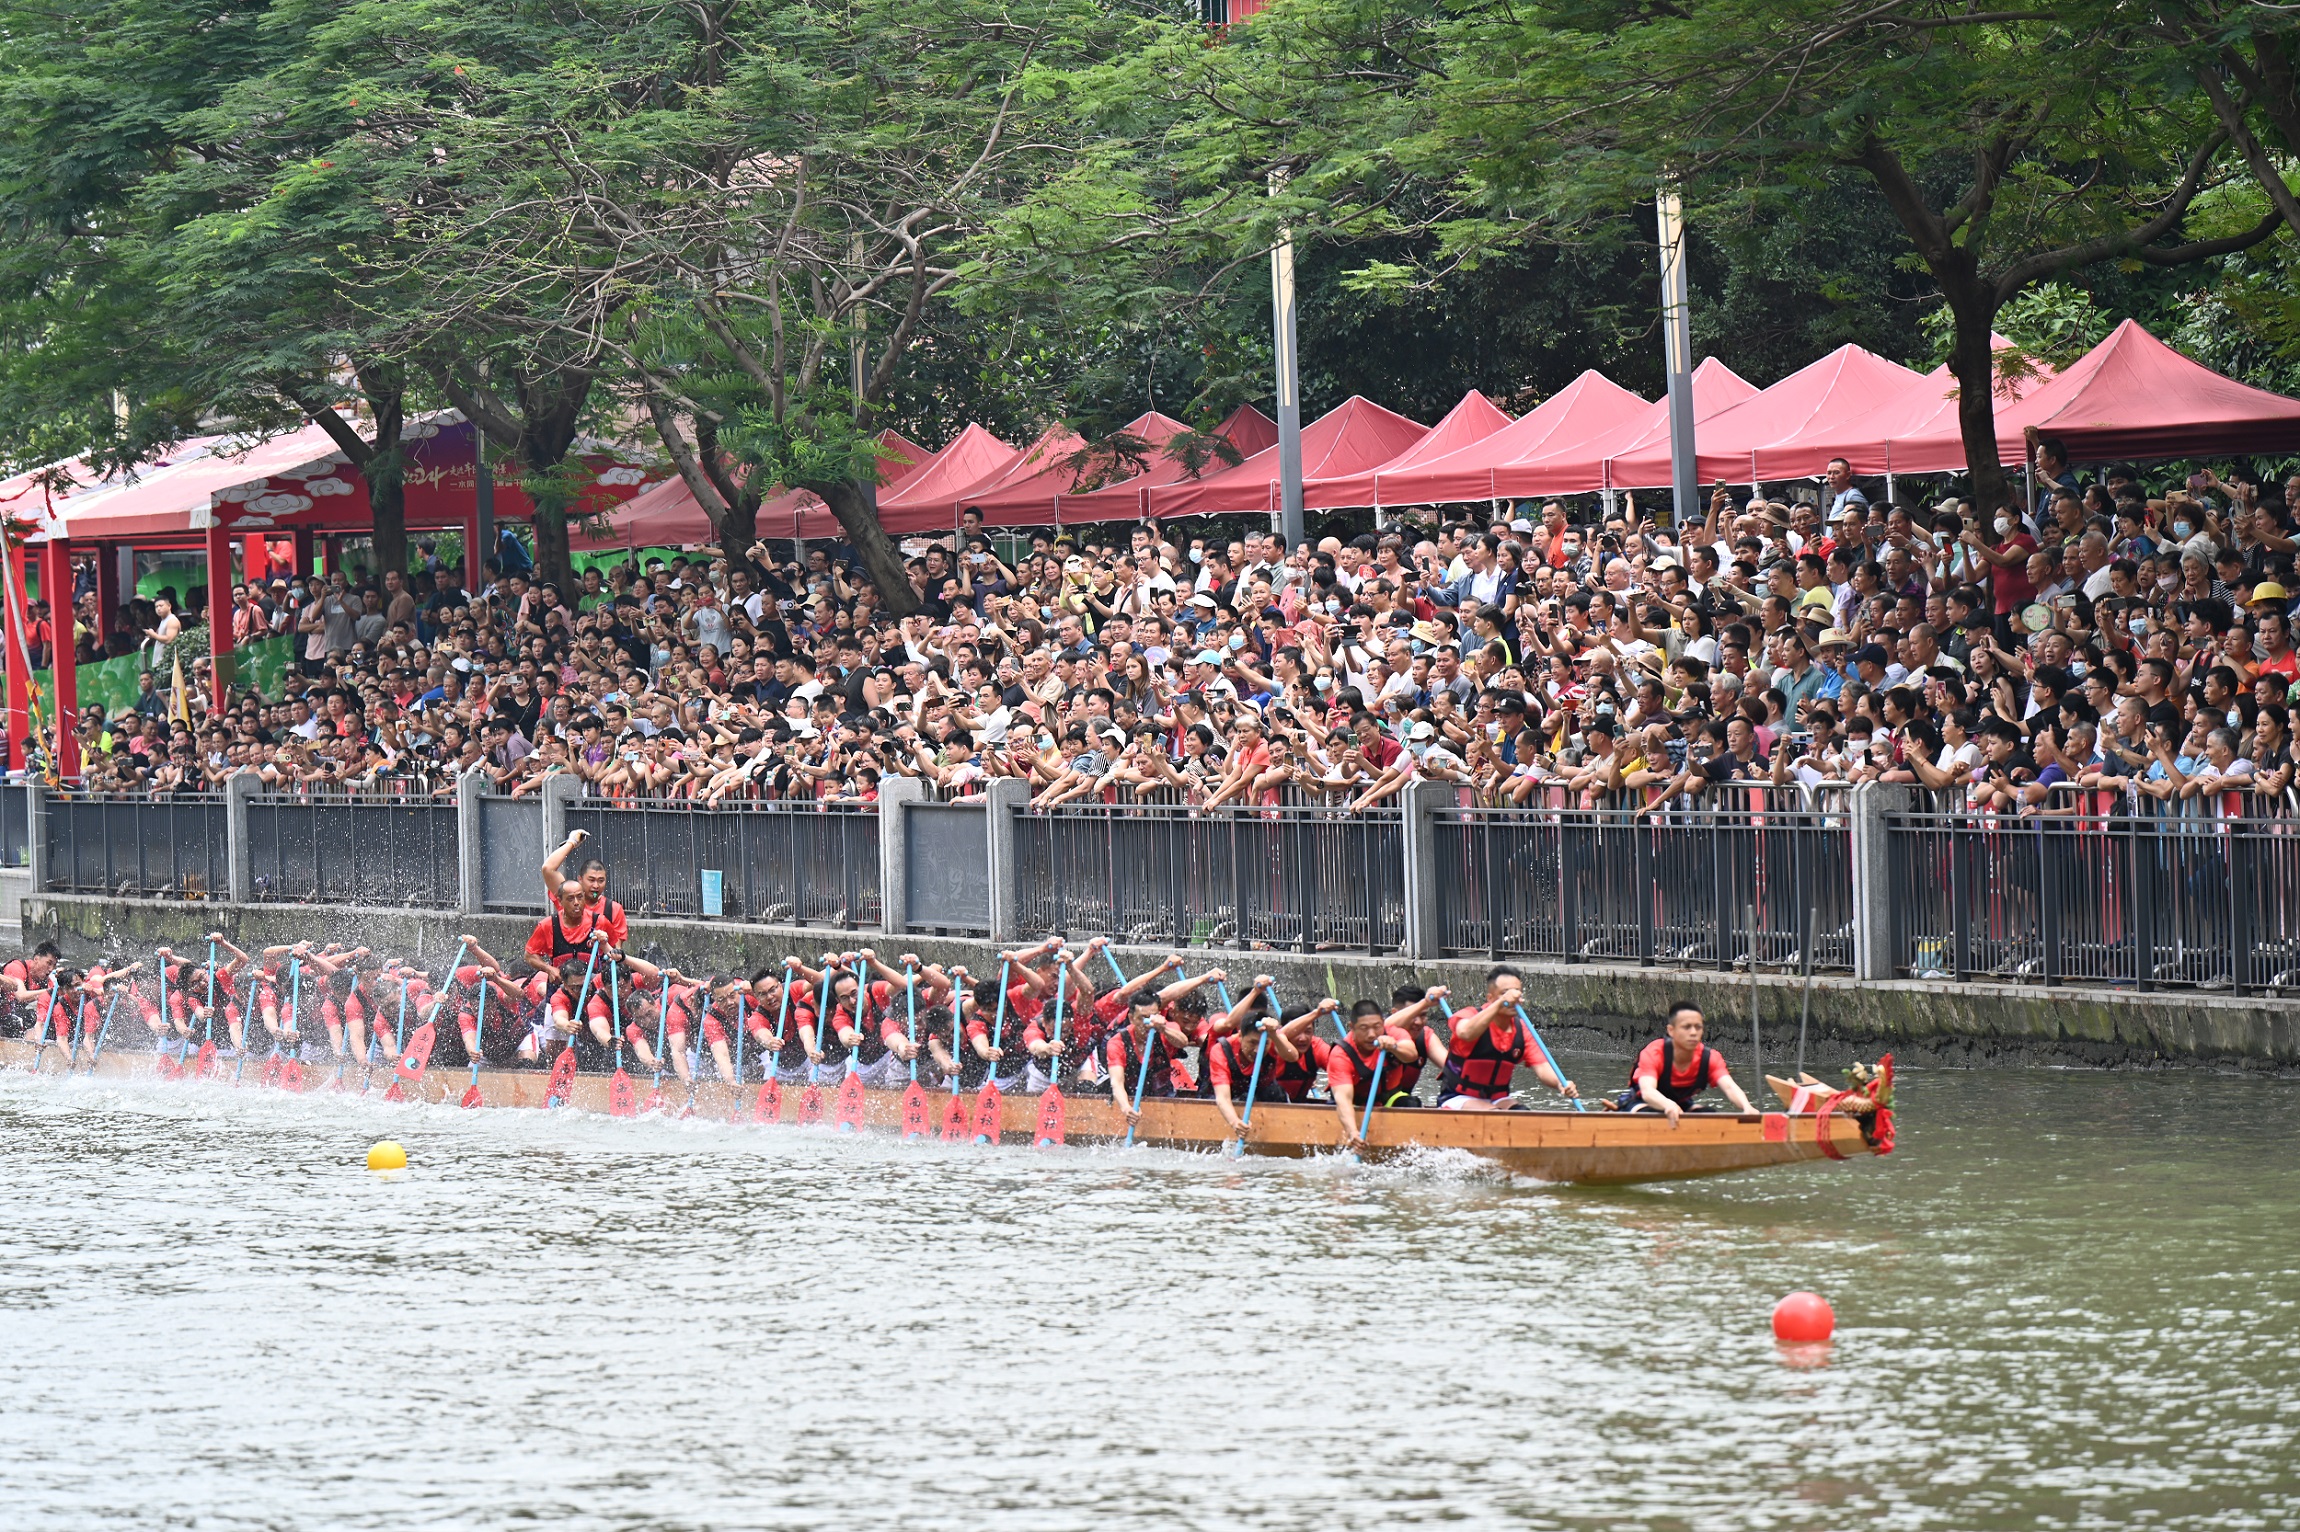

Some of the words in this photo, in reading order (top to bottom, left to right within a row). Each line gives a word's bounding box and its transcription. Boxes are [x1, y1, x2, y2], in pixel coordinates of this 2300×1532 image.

[908, 1096, 922, 1125] 西社
[979, 1097, 996, 1126] 西社
[1043, 1100, 1058, 1131] 西社
